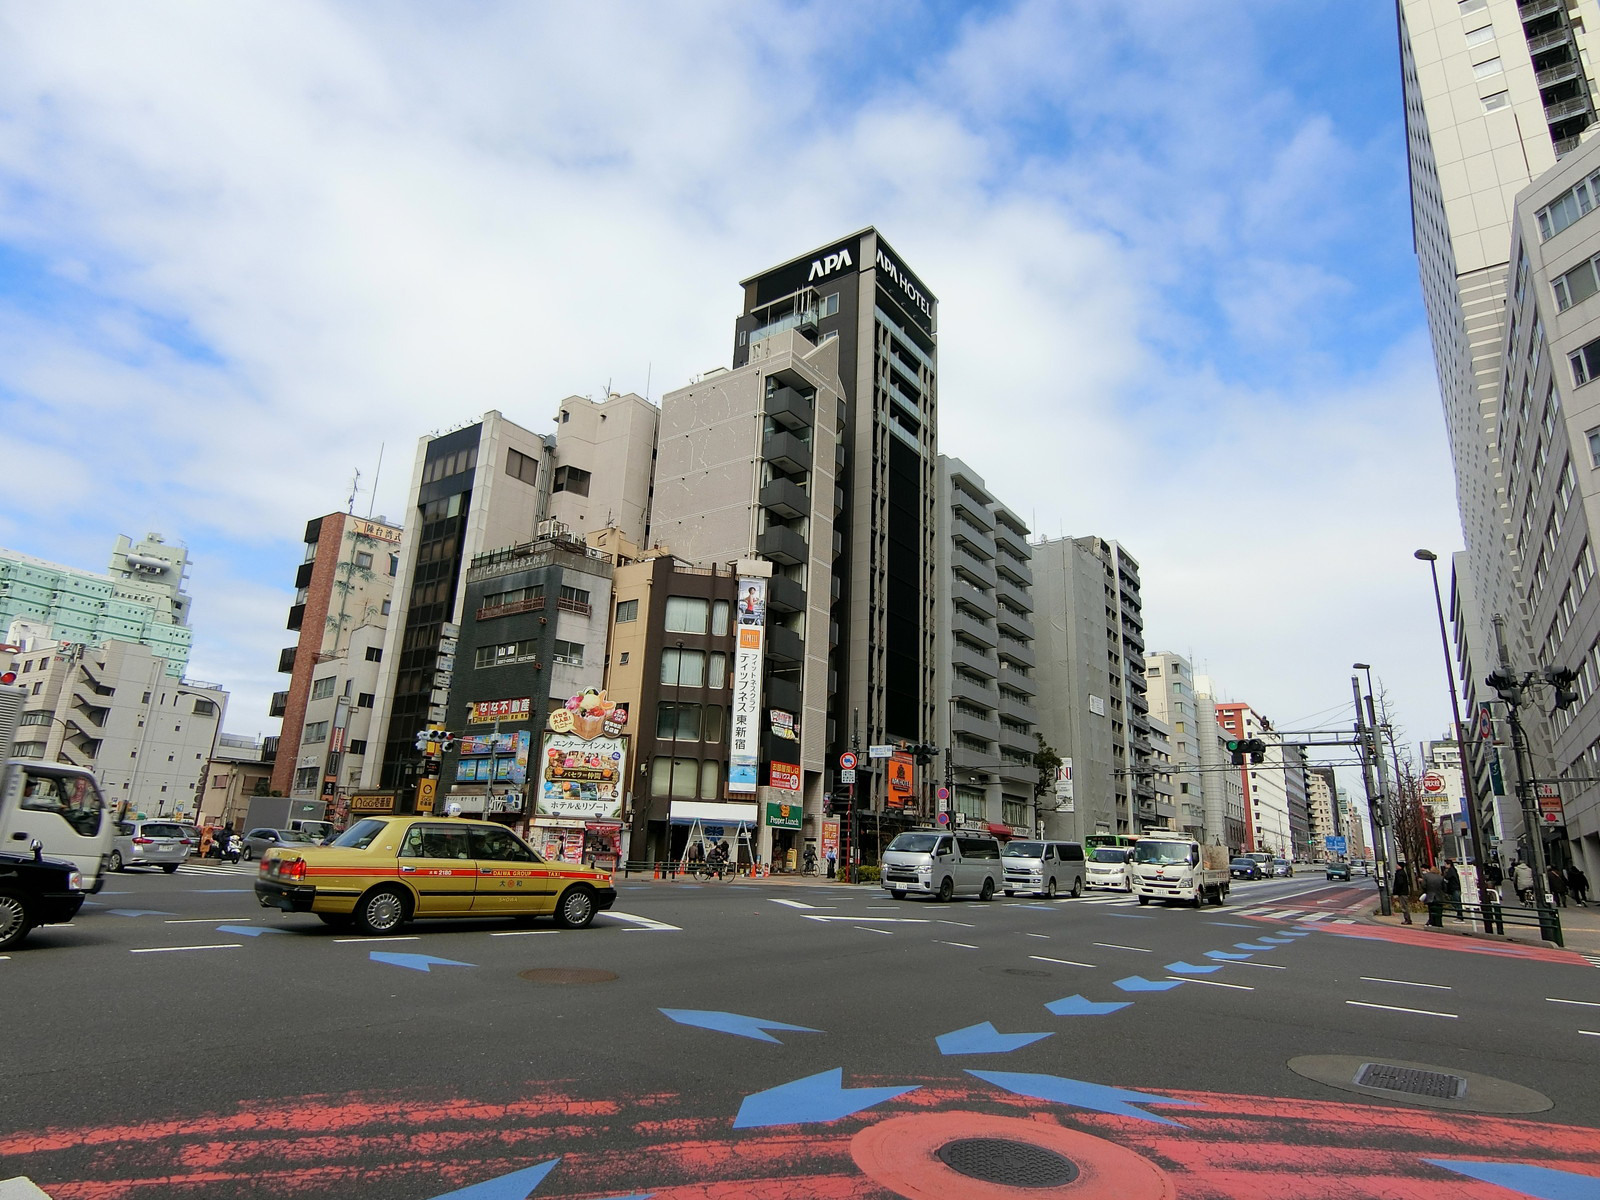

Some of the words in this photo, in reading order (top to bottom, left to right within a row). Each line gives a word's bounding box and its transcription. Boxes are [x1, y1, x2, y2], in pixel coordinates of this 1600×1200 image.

[808, 249, 852, 281] APA
[876, 249, 898, 283] APA
[899, 272, 932, 319] HOTEL
[749, 654, 758, 712] フィットネスクラブ
[735, 653, 749, 750] ティップネス東新宿
[553, 740, 618, 751] エンターテインメント
[551, 801, 608, 811] ホテル&リゾート
[770, 816, 785, 825] Pepper
[785, 817, 799, 826] Lunch
